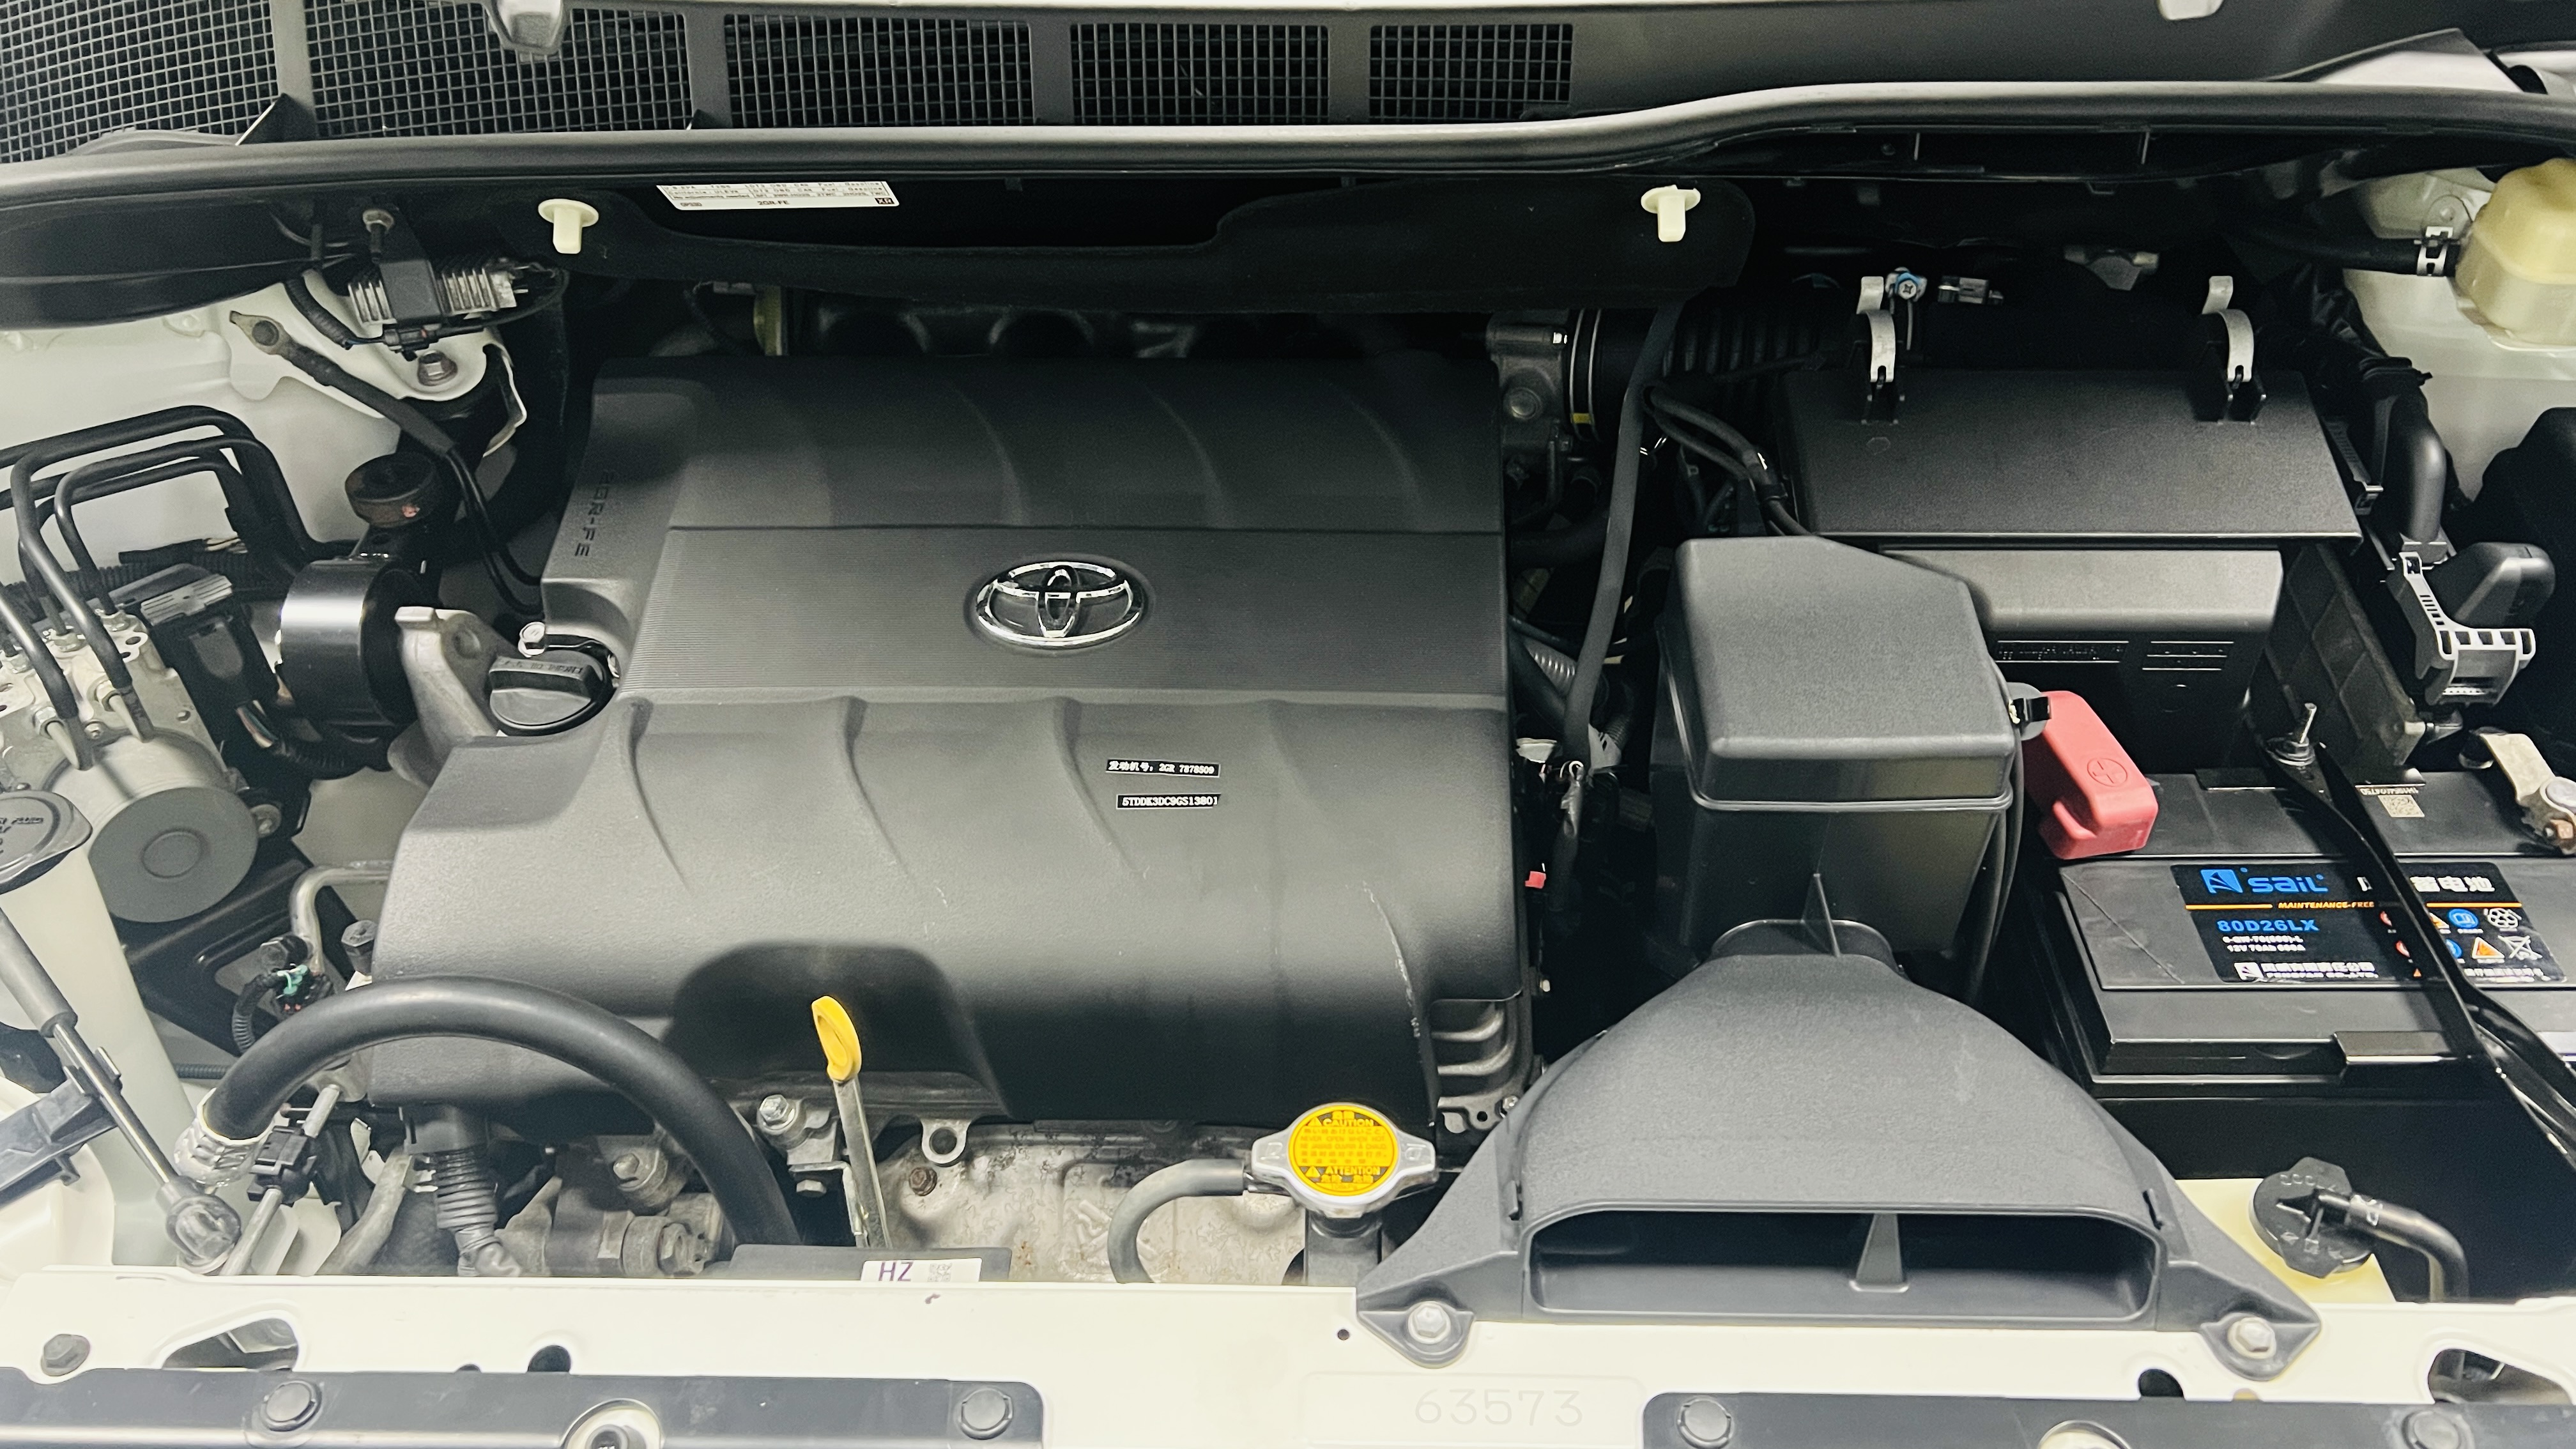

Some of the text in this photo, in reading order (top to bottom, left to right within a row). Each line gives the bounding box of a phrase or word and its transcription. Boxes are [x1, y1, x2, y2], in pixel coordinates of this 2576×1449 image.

[2217, 919, 2319, 932] 80D26LX
[1322, 1118, 1374, 1126] CAUTION
[1325, 1165, 1380, 1176] ATTENTION
[878, 1261, 914, 1282] HZ
[1414, 1388, 1583, 1427] 63573
